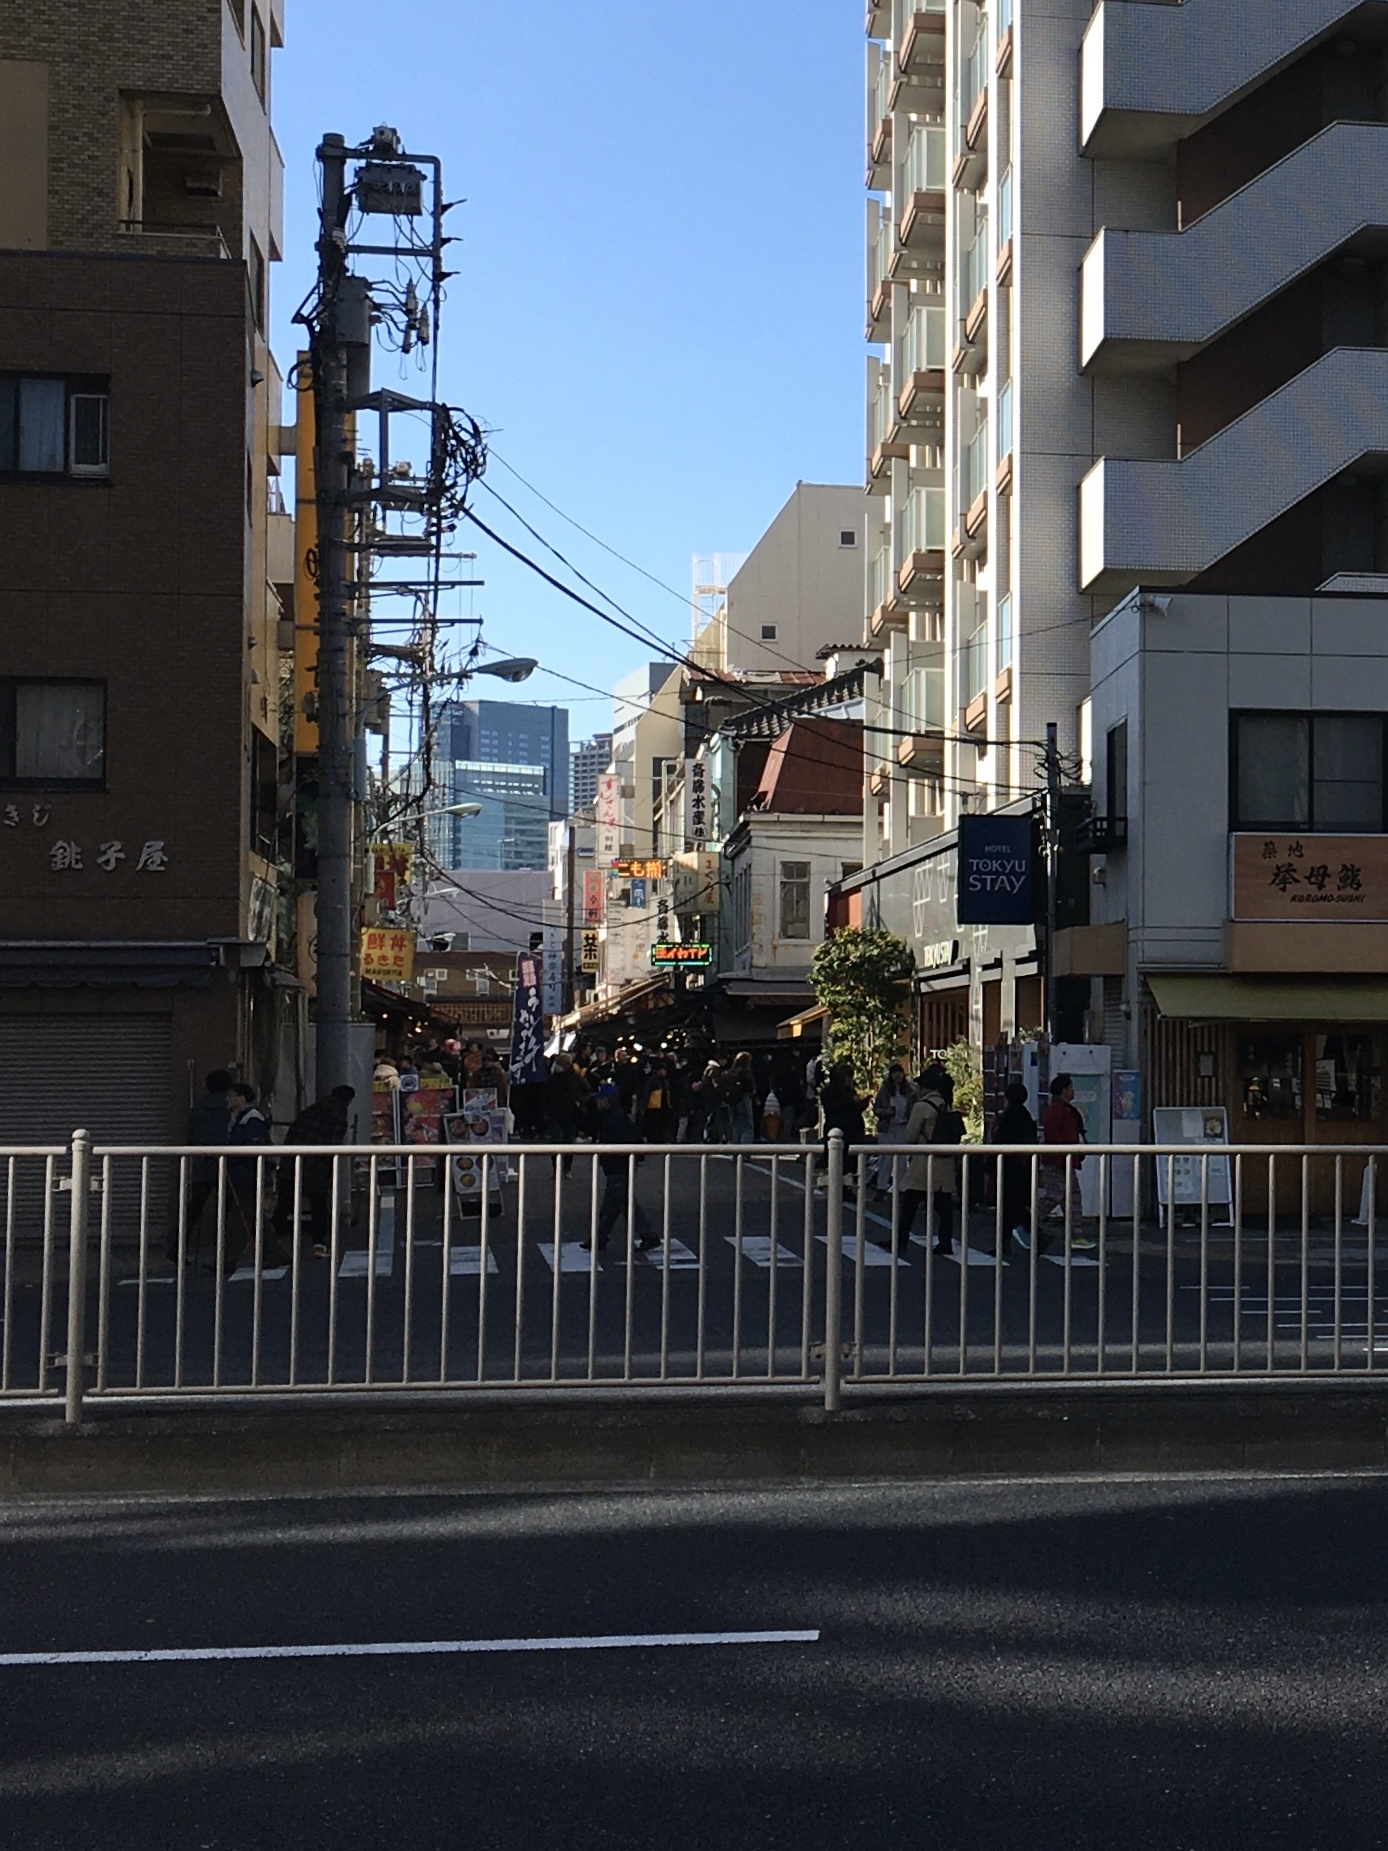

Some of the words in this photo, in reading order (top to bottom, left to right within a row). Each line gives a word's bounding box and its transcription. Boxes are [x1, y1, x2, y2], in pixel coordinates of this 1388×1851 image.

[50, 840, 169, 872] 銚子屋
[984, 845, 1012, 854] HOTEL
[1262, 840, 1304, 860] 築地
[968, 858, 1026, 873] TOKYU
[968, 875, 1026, 895] STAY
